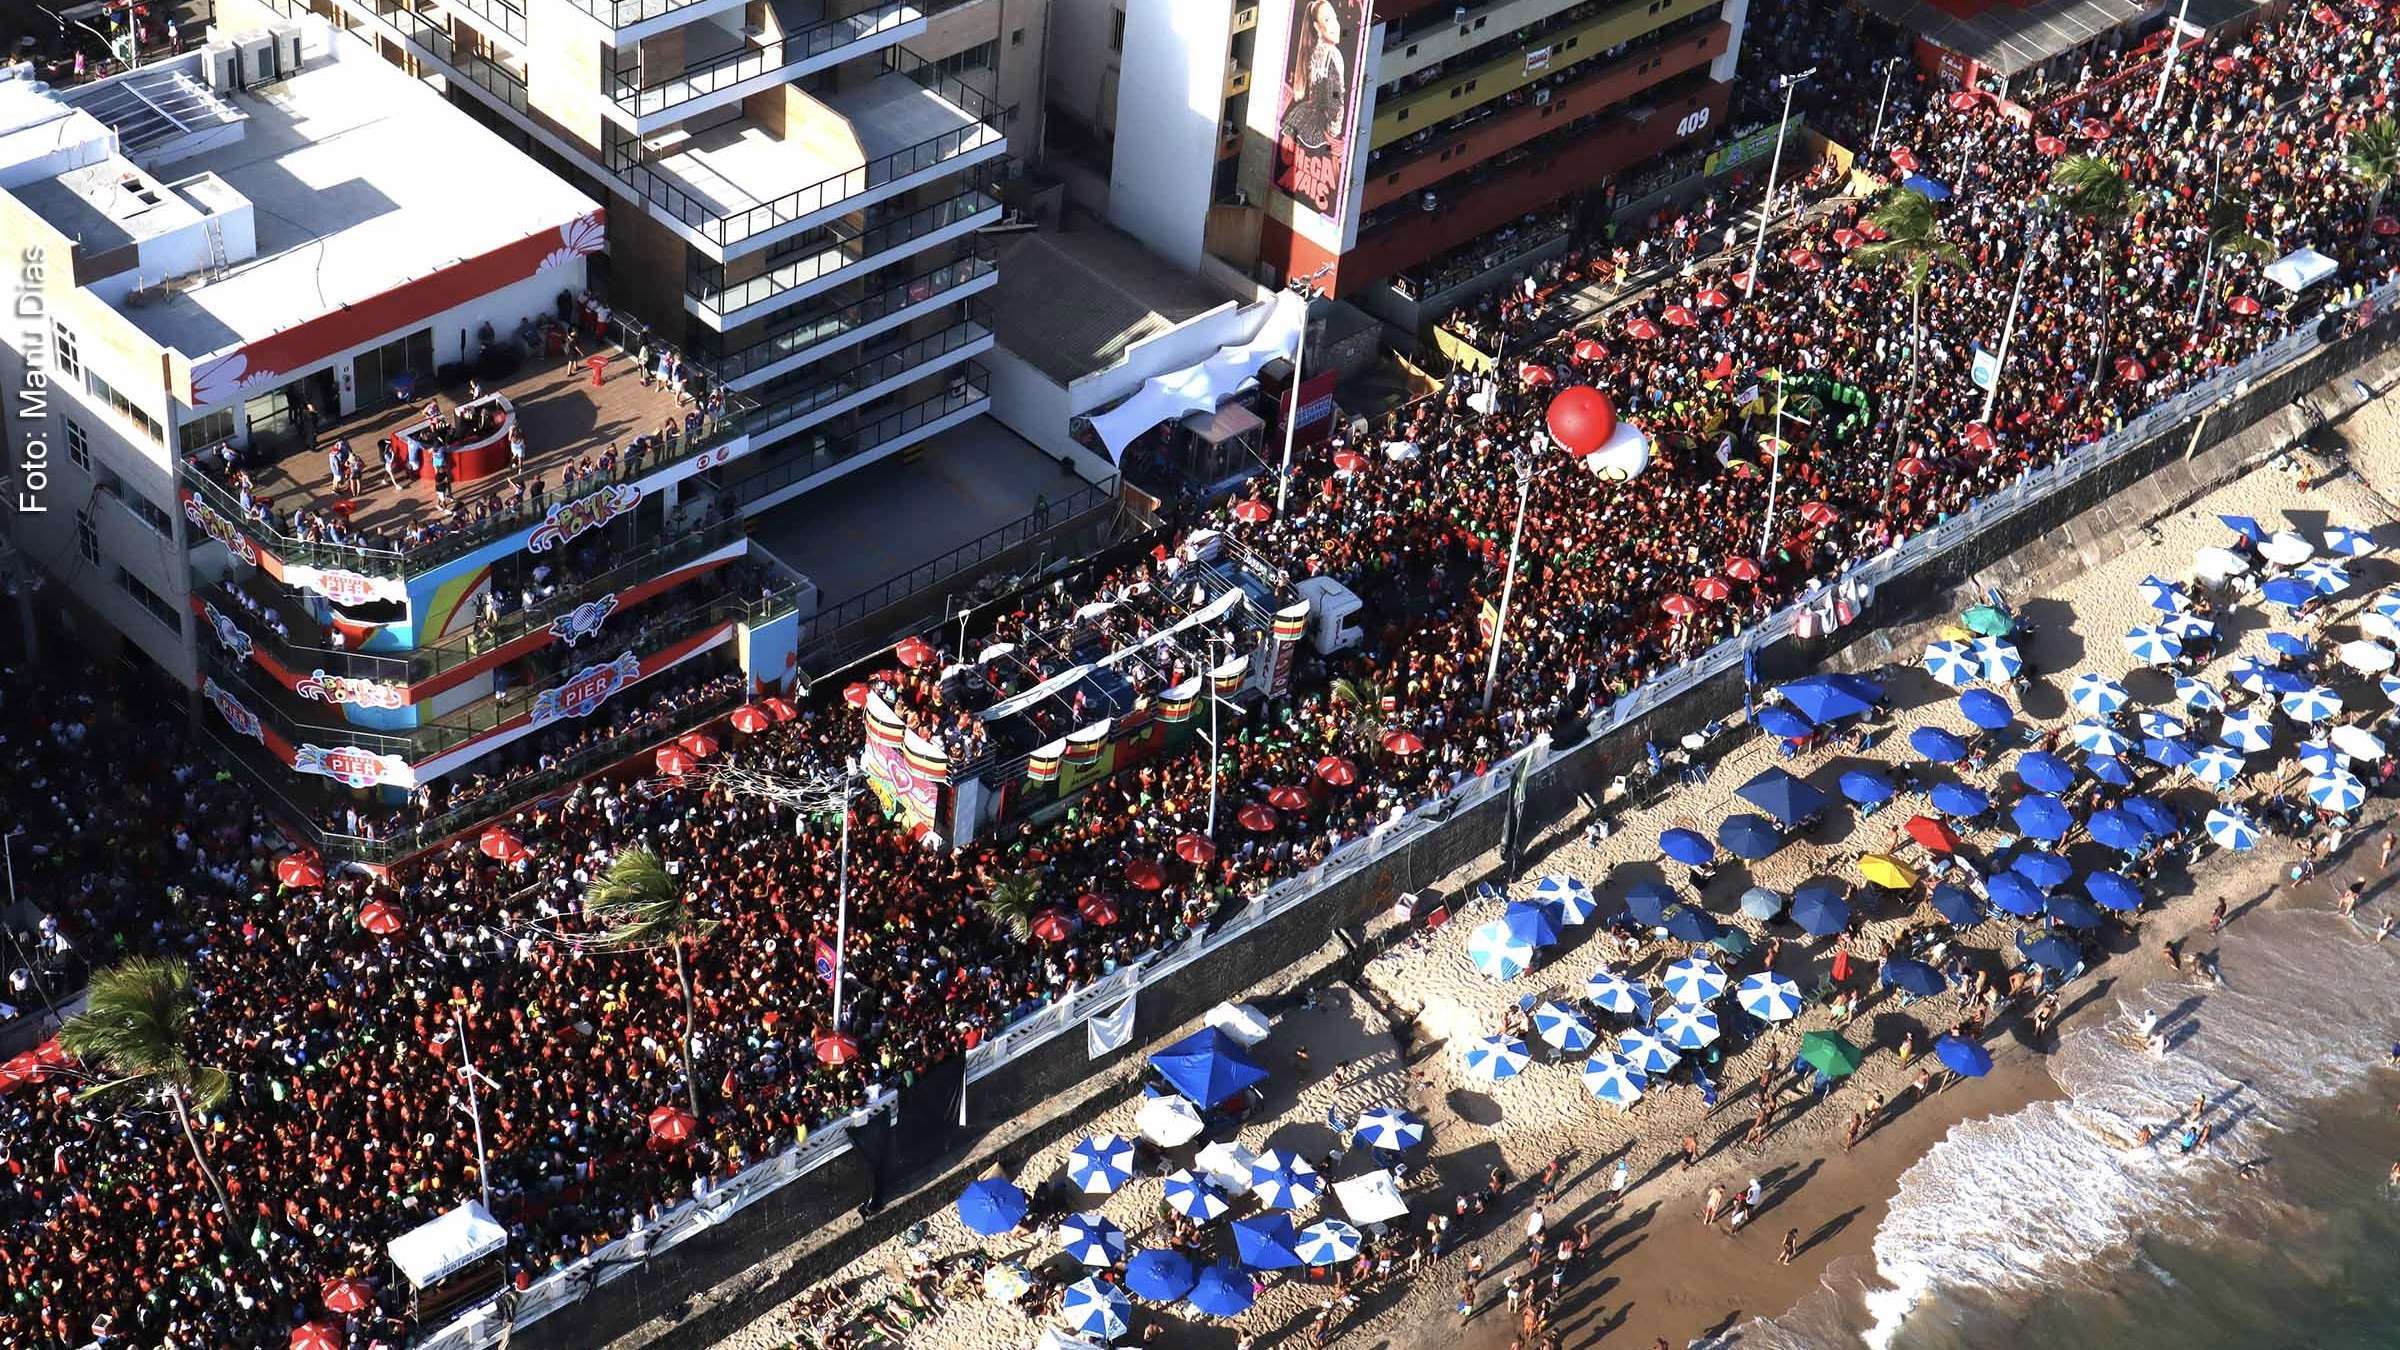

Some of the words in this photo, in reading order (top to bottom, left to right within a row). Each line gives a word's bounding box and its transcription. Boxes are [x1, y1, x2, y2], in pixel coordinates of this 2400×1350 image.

[1676, 107, 1709, 137] 409
[327, 581, 363, 595] PIER
[566, 677, 607, 707] PIER
[332, 759, 376, 776] PIER
